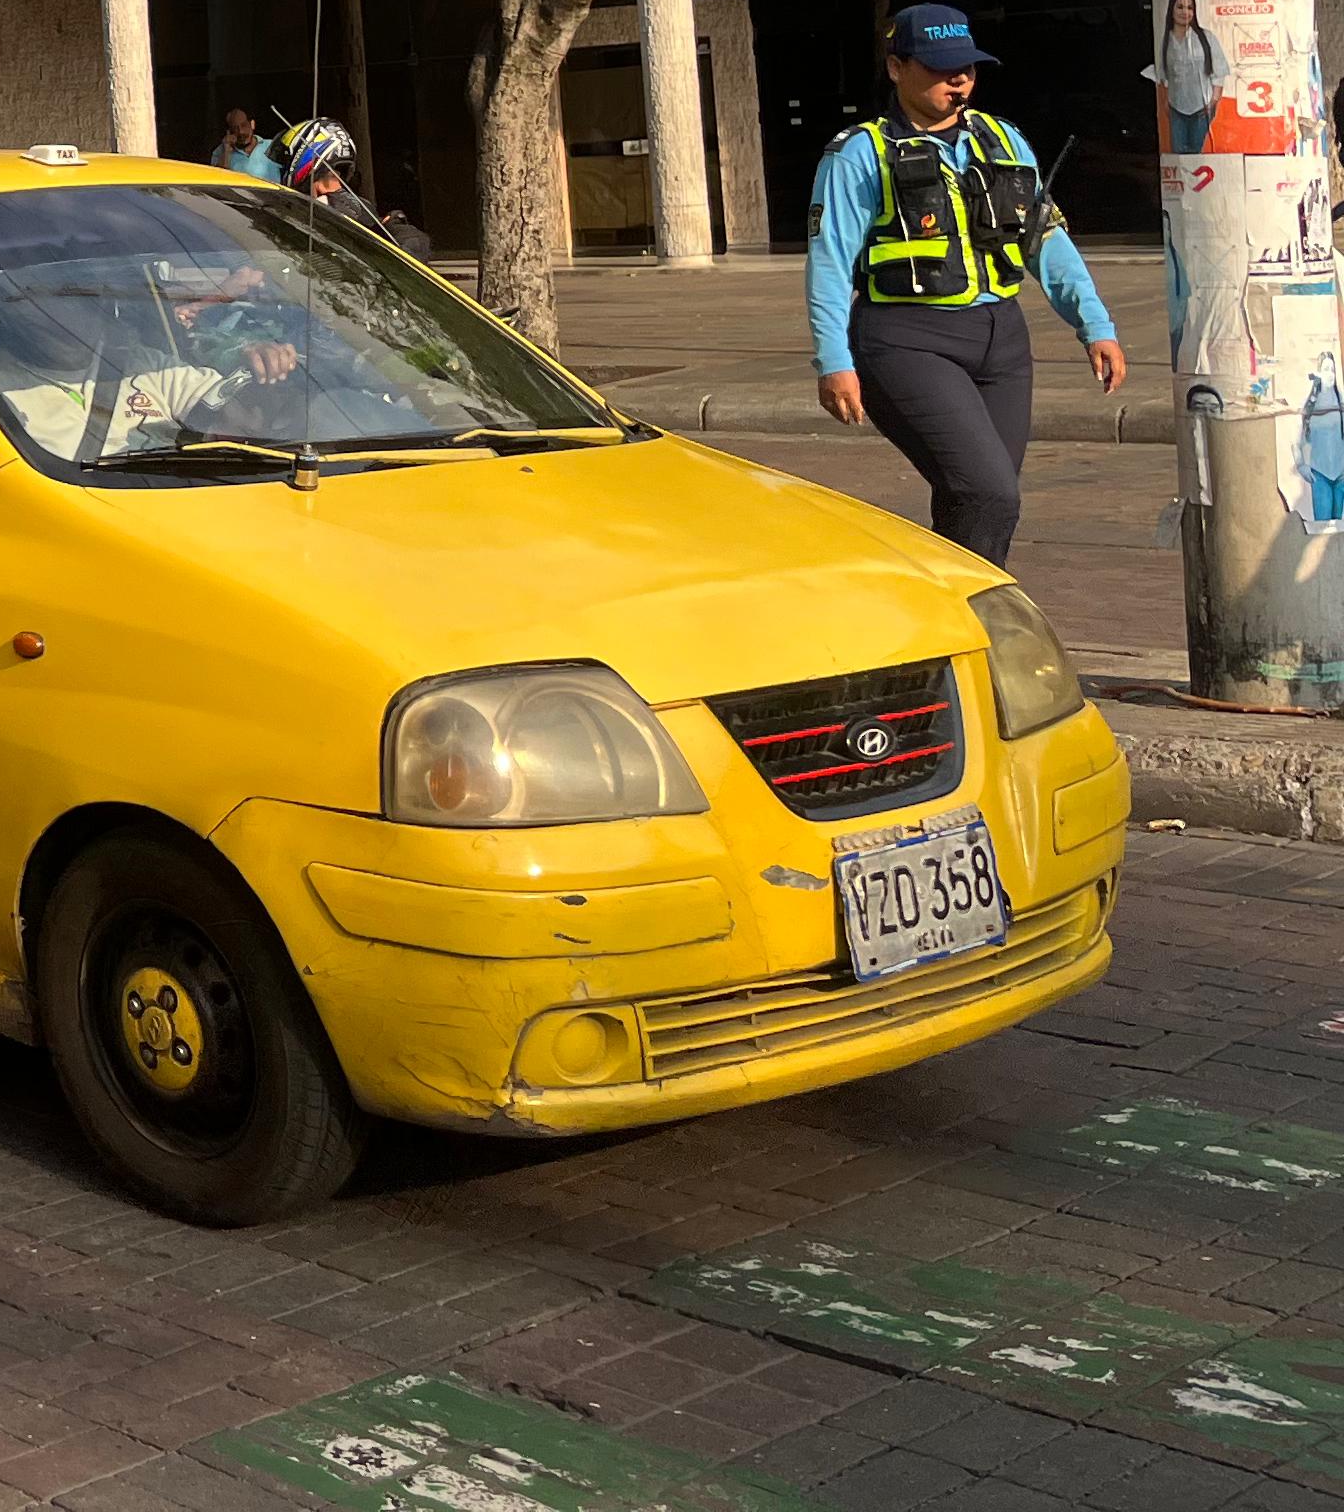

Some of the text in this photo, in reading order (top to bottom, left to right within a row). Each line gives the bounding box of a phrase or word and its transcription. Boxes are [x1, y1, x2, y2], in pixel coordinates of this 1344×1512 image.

[1219, 5, 1272, 15] CONCEJO
[1247, 81, 1274, 113] 3
[848, 845, 995, 942] VZD 358
